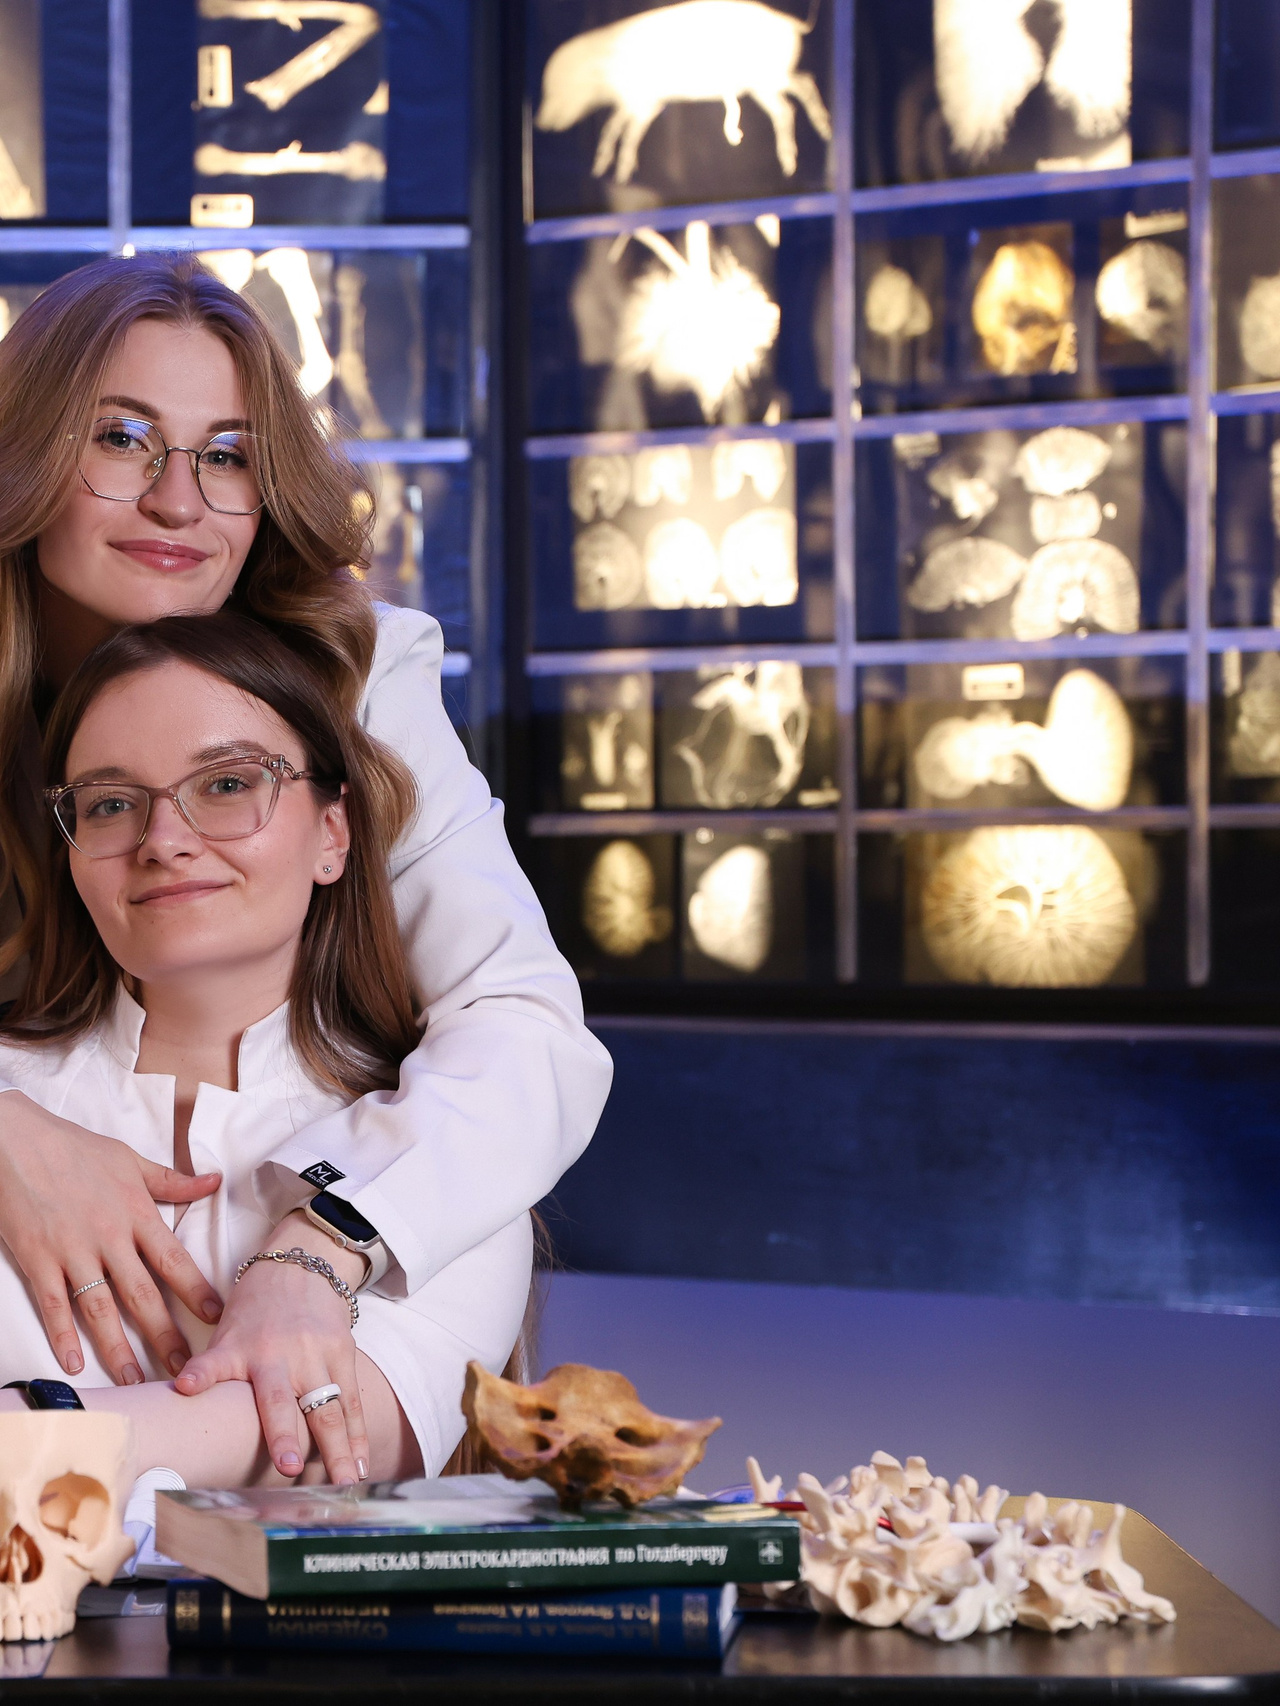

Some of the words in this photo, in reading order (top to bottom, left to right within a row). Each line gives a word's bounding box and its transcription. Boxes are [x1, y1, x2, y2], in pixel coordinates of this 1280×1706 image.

[304, 1553, 420, 1572] КЛИНИЧЕСКАЯ
[422, 1549, 610, 1569] ЭЛЕКТРОКАРДИОГРАФИЯ
[615, 1547, 635, 1563] по
